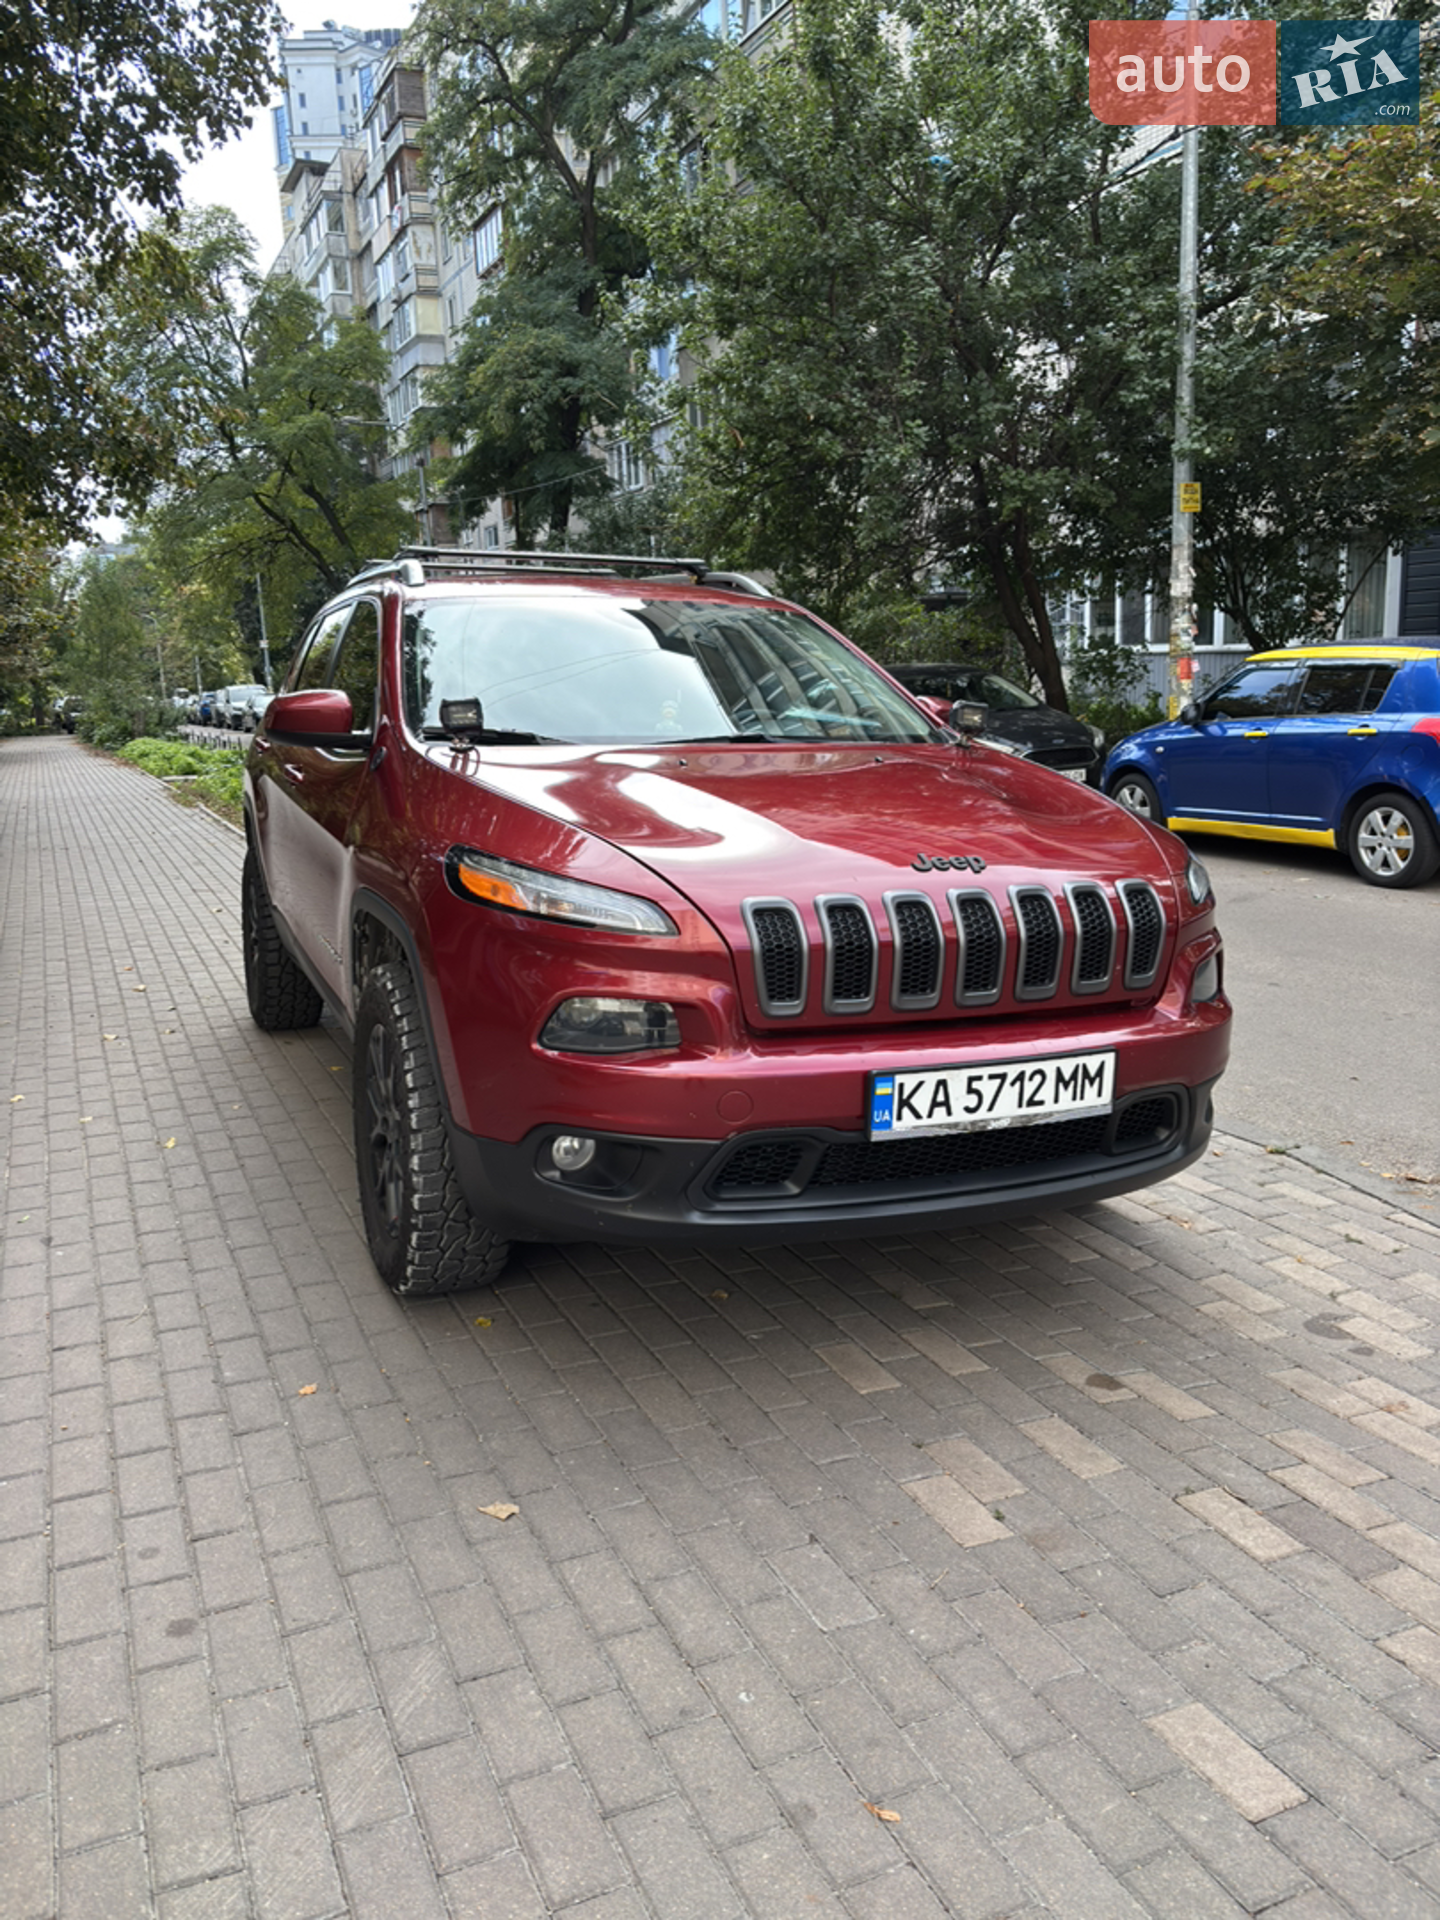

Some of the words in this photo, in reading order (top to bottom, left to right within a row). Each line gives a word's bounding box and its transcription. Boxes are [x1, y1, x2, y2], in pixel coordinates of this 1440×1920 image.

[910, 853, 987, 875] Jeep
[896, 1079, 953, 1122] KA
[963, 1068, 1047, 1114] 5712
[1053, 1060, 1106, 1105] MM
[873, 1109, 891, 1123] UA
